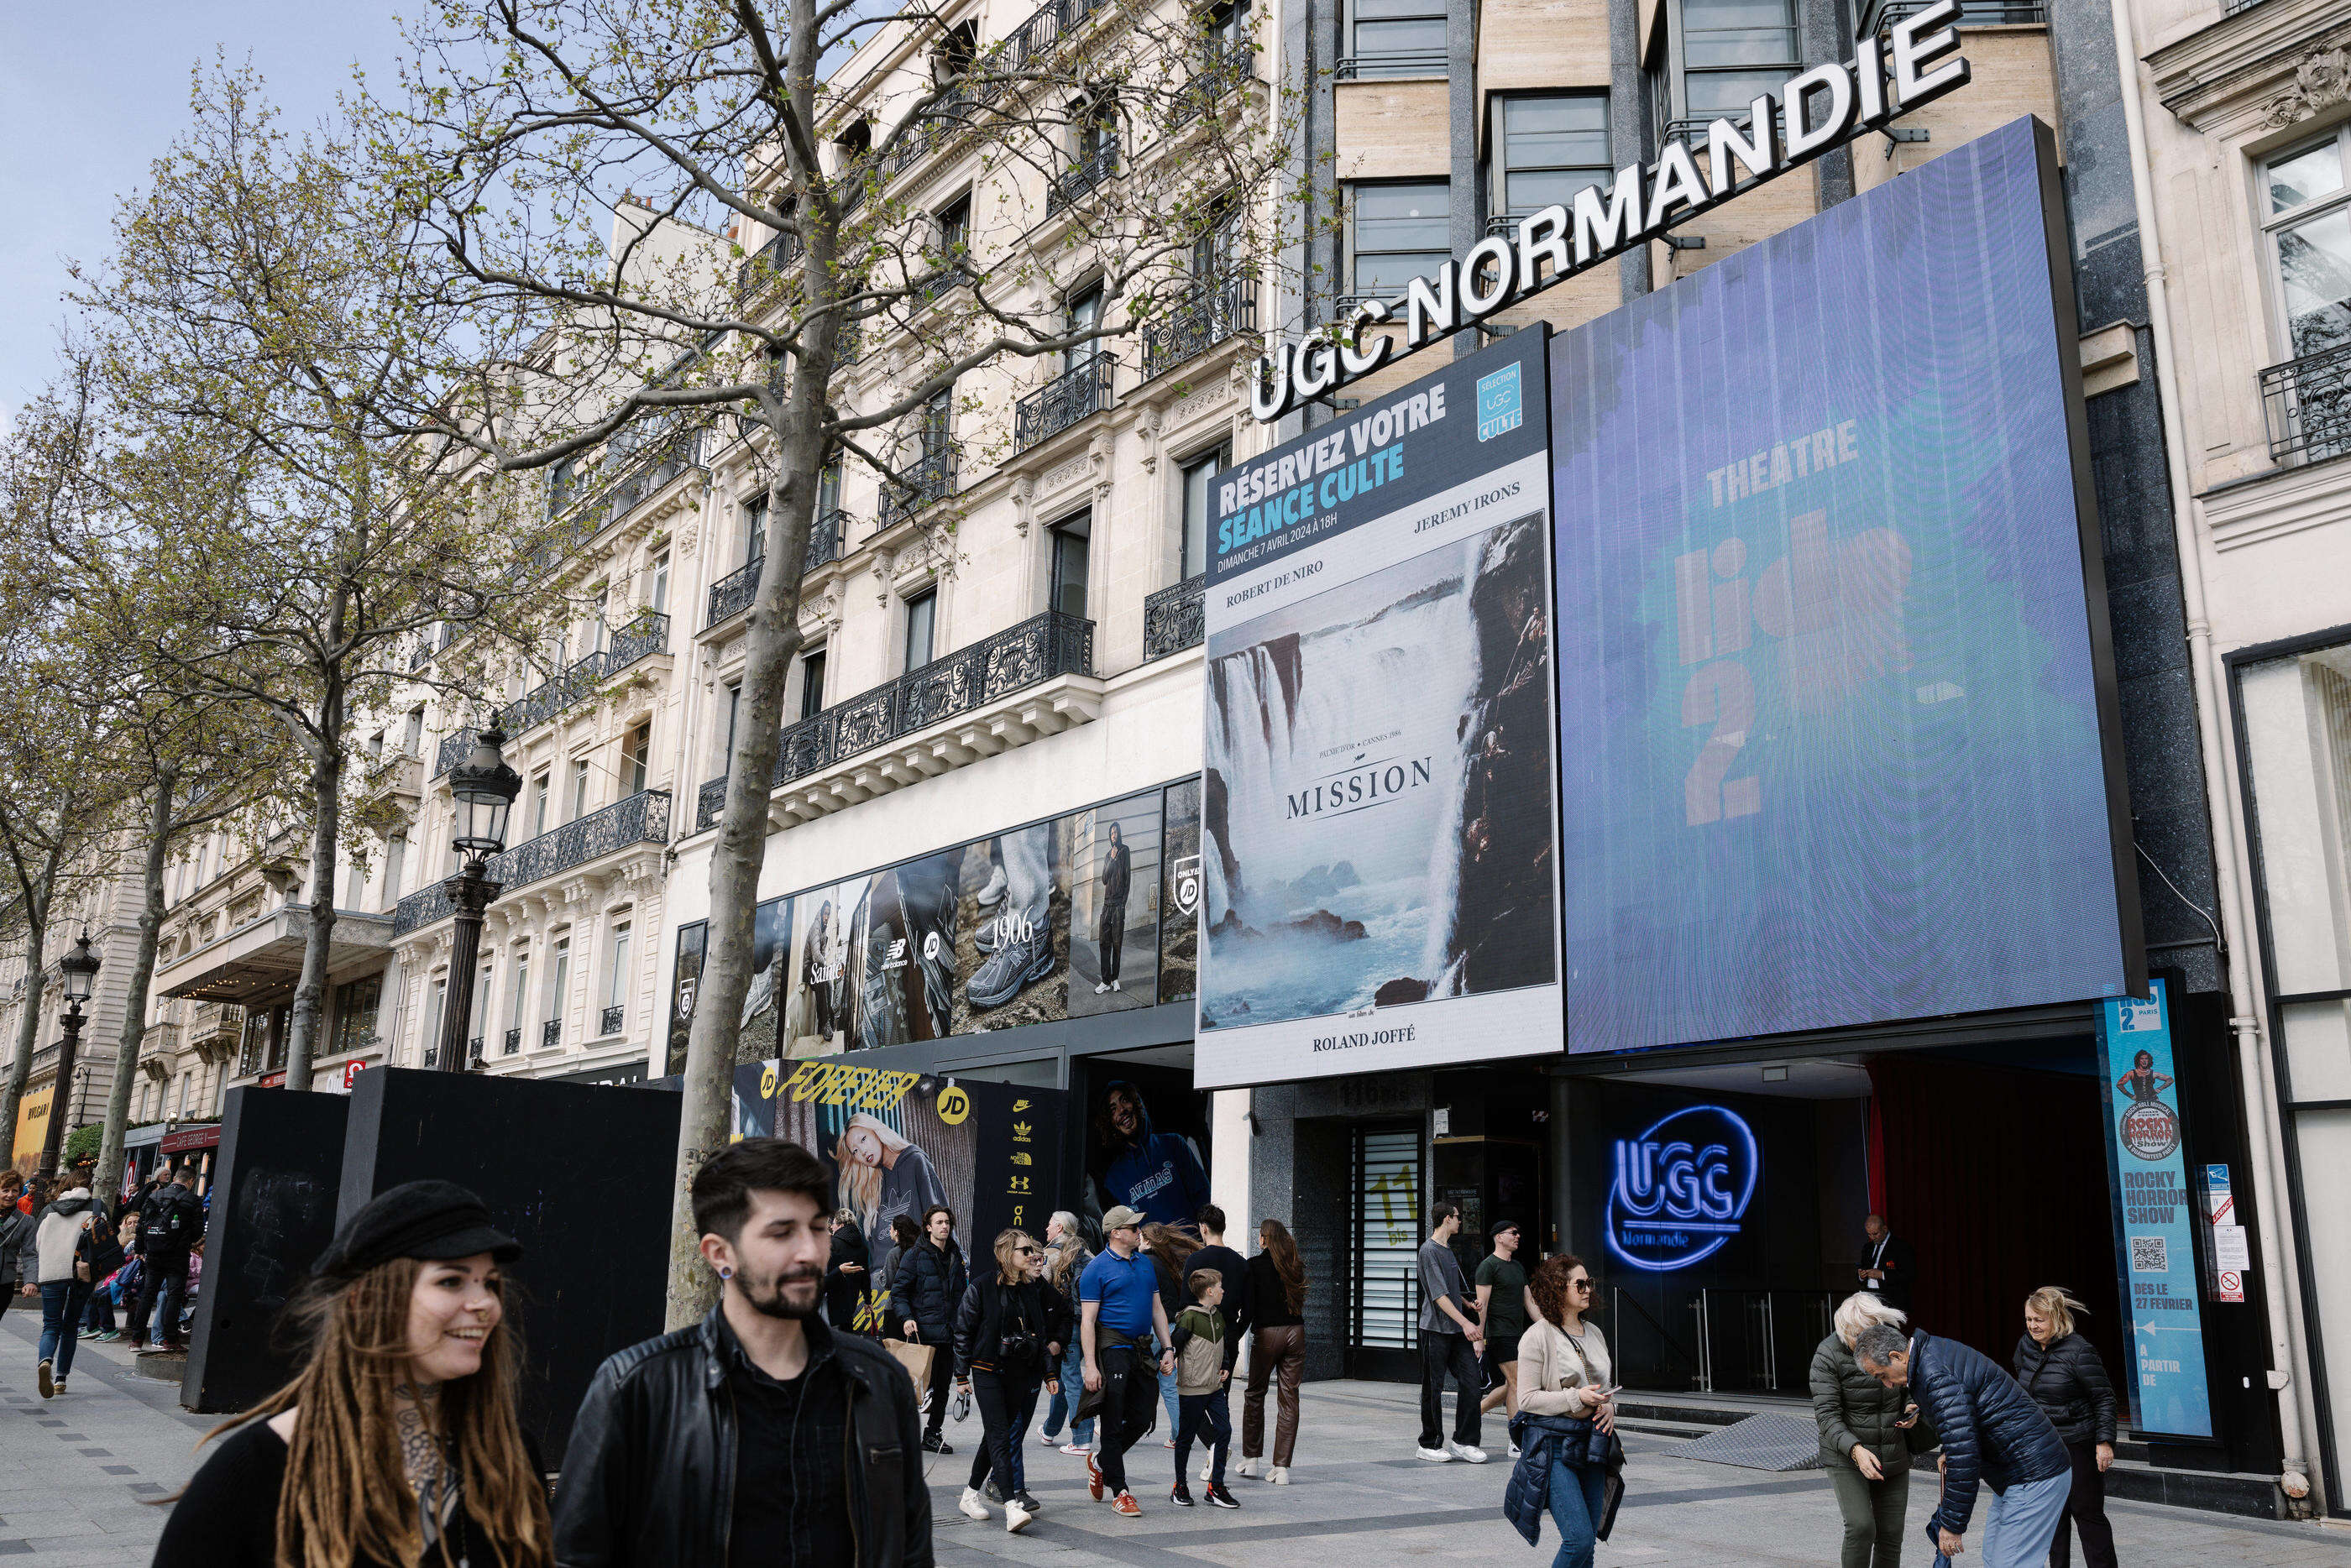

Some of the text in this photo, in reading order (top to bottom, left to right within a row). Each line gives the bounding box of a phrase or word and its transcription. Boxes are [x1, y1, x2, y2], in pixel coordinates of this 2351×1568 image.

[1251, 0, 1971, 423] UGC NORMANDIE
[1482, 369, 1516, 392] SÉLECTION
[1487, 390, 1511, 410] UGC
[1478, 408, 1522, 442] CULTE
[1220, 383, 1446, 517] RÉSERVEZ VOTRE
[1706, 418, 1859, 510] THÉÂTRE
[1217, 443, 1404, 554] SÉANCE CULTE
[1414, 481, 1521, 534] JEREMY IRONS
[1217, 512, 1338, 573] DIMANCHE 7 AVRIL 2024 À 18H
[1226, 560, 1323, 608] ROBERT DE NIRO
[1362, 734, 1389, 747] CANNES
[1286, 756, 1432, 820] MISSION
[1177, 867, 1194, 879] ONLY
[1183, 884, 1195, 899] JD
[992, 905, 1034, 953] 1906
[926, 937, 938, 954] JD
[2121, 1008, 2135, 1031] 2
[1312, 1023, 1416, 1052] ROLAND JOFFÉ
[762, 1074, 774, 1090] JD
[777, 1060, 922, 1111] FOREVER
[941, 1095, 966, 1116] JD
[2127, 1116, 2173, 1131] ROCKY
[1129, 1168, 1173, 1204] ADIDAS
[1616, 1140, 1734, 1219] UGC
[2124, 1171, 2176, 1189] ROCKY
[2126, 1189, 2187, 1206] HORROR
[2128, 1206, 2175, 1224] SHOW
[1388, 1228, 1408, 1246] bis
[1621, 1230, 1690, 1248] Normandie
[2157, 1283, 2168, 1295] LE
[2135, 1298, 2147, 1309] 27
[2141, 1359, 2181, 1372] PARTIR
[2143, 1373, 2156, 1386] DE
